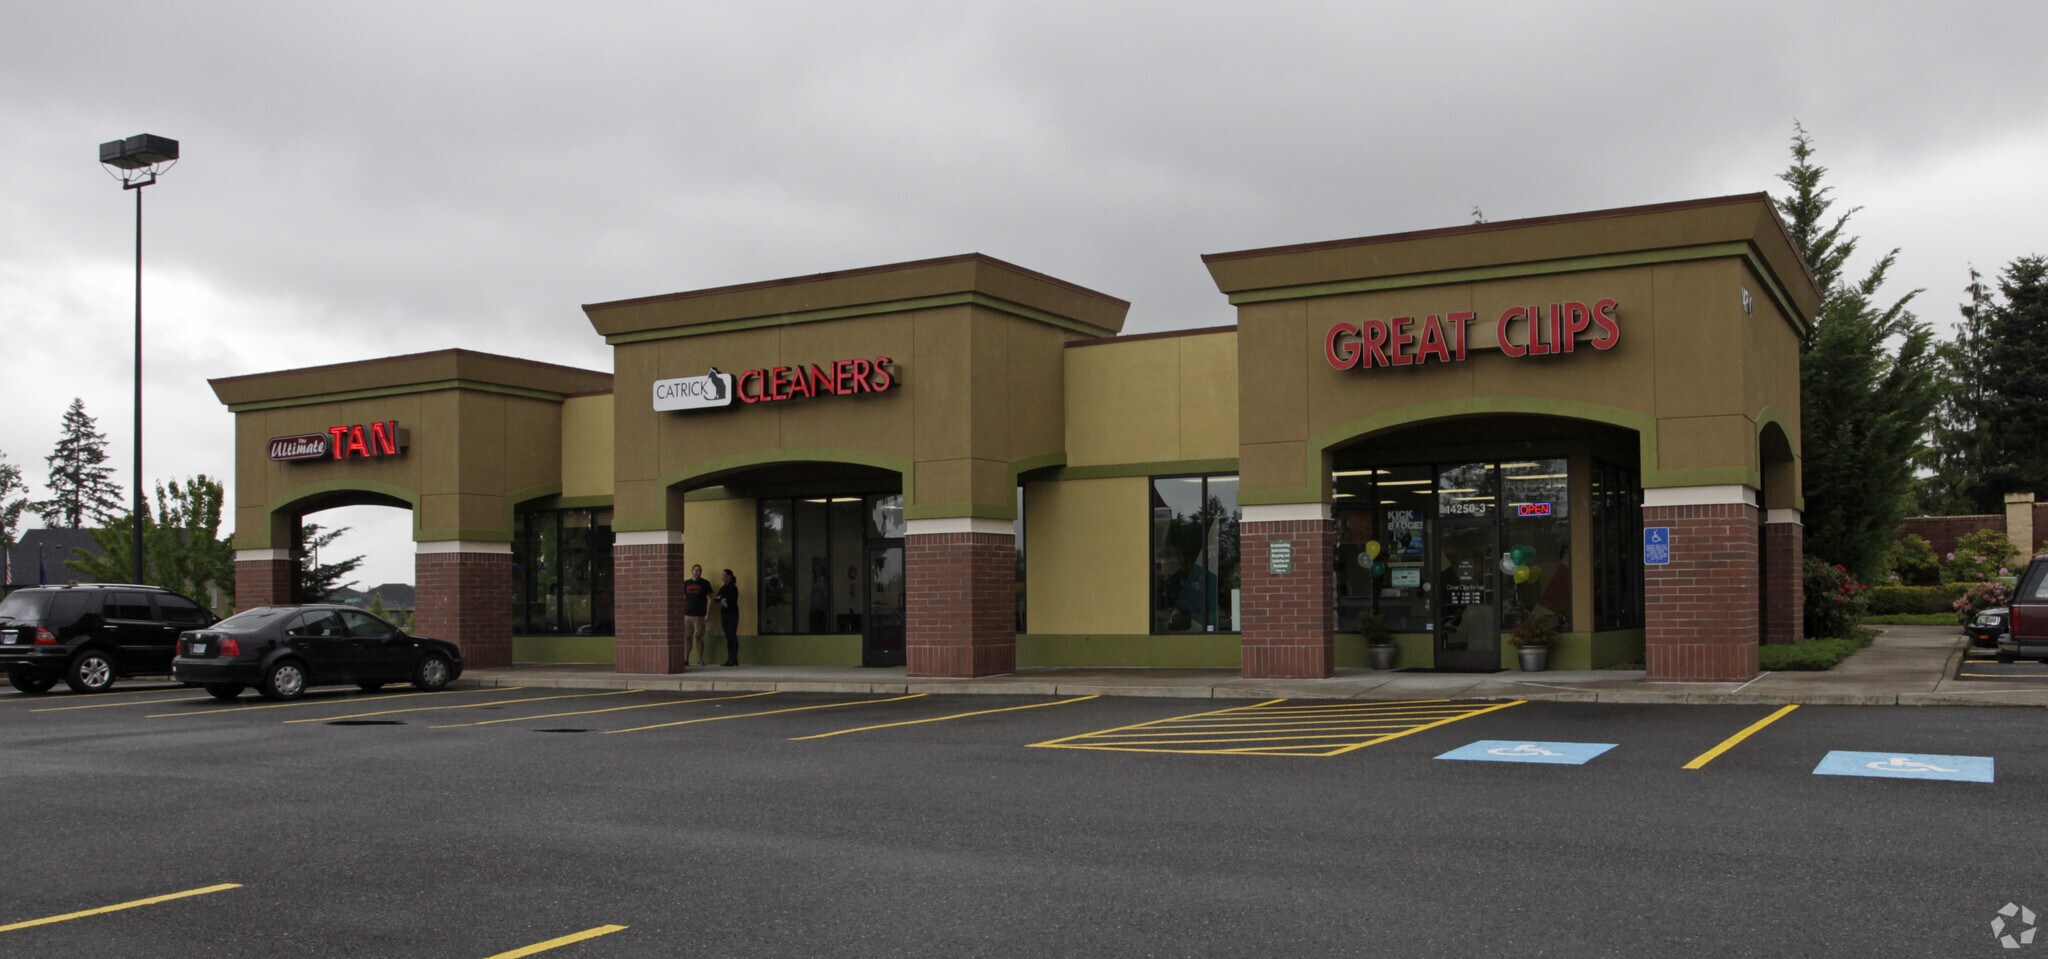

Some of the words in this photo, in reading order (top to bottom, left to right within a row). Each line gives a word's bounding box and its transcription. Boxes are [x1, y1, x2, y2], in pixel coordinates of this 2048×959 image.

[1324, 311, 1475, 371] GREAT
[1495, 297, 1620, 357] CLIPS
[656, 380, 708, 400] CATRICK
[738, 356, 892, 403] CLEANERS
[271, 440, 324, 457] Ultimate
[328, 421, 398, 459] TAN
[1445, 503, 1486, 514] 14250-3
[1520, 505, 1549, 515] OPEN
[1387, 510, 1414, 519] KICK
[1387, 521, 1424, 530] BADGE!
